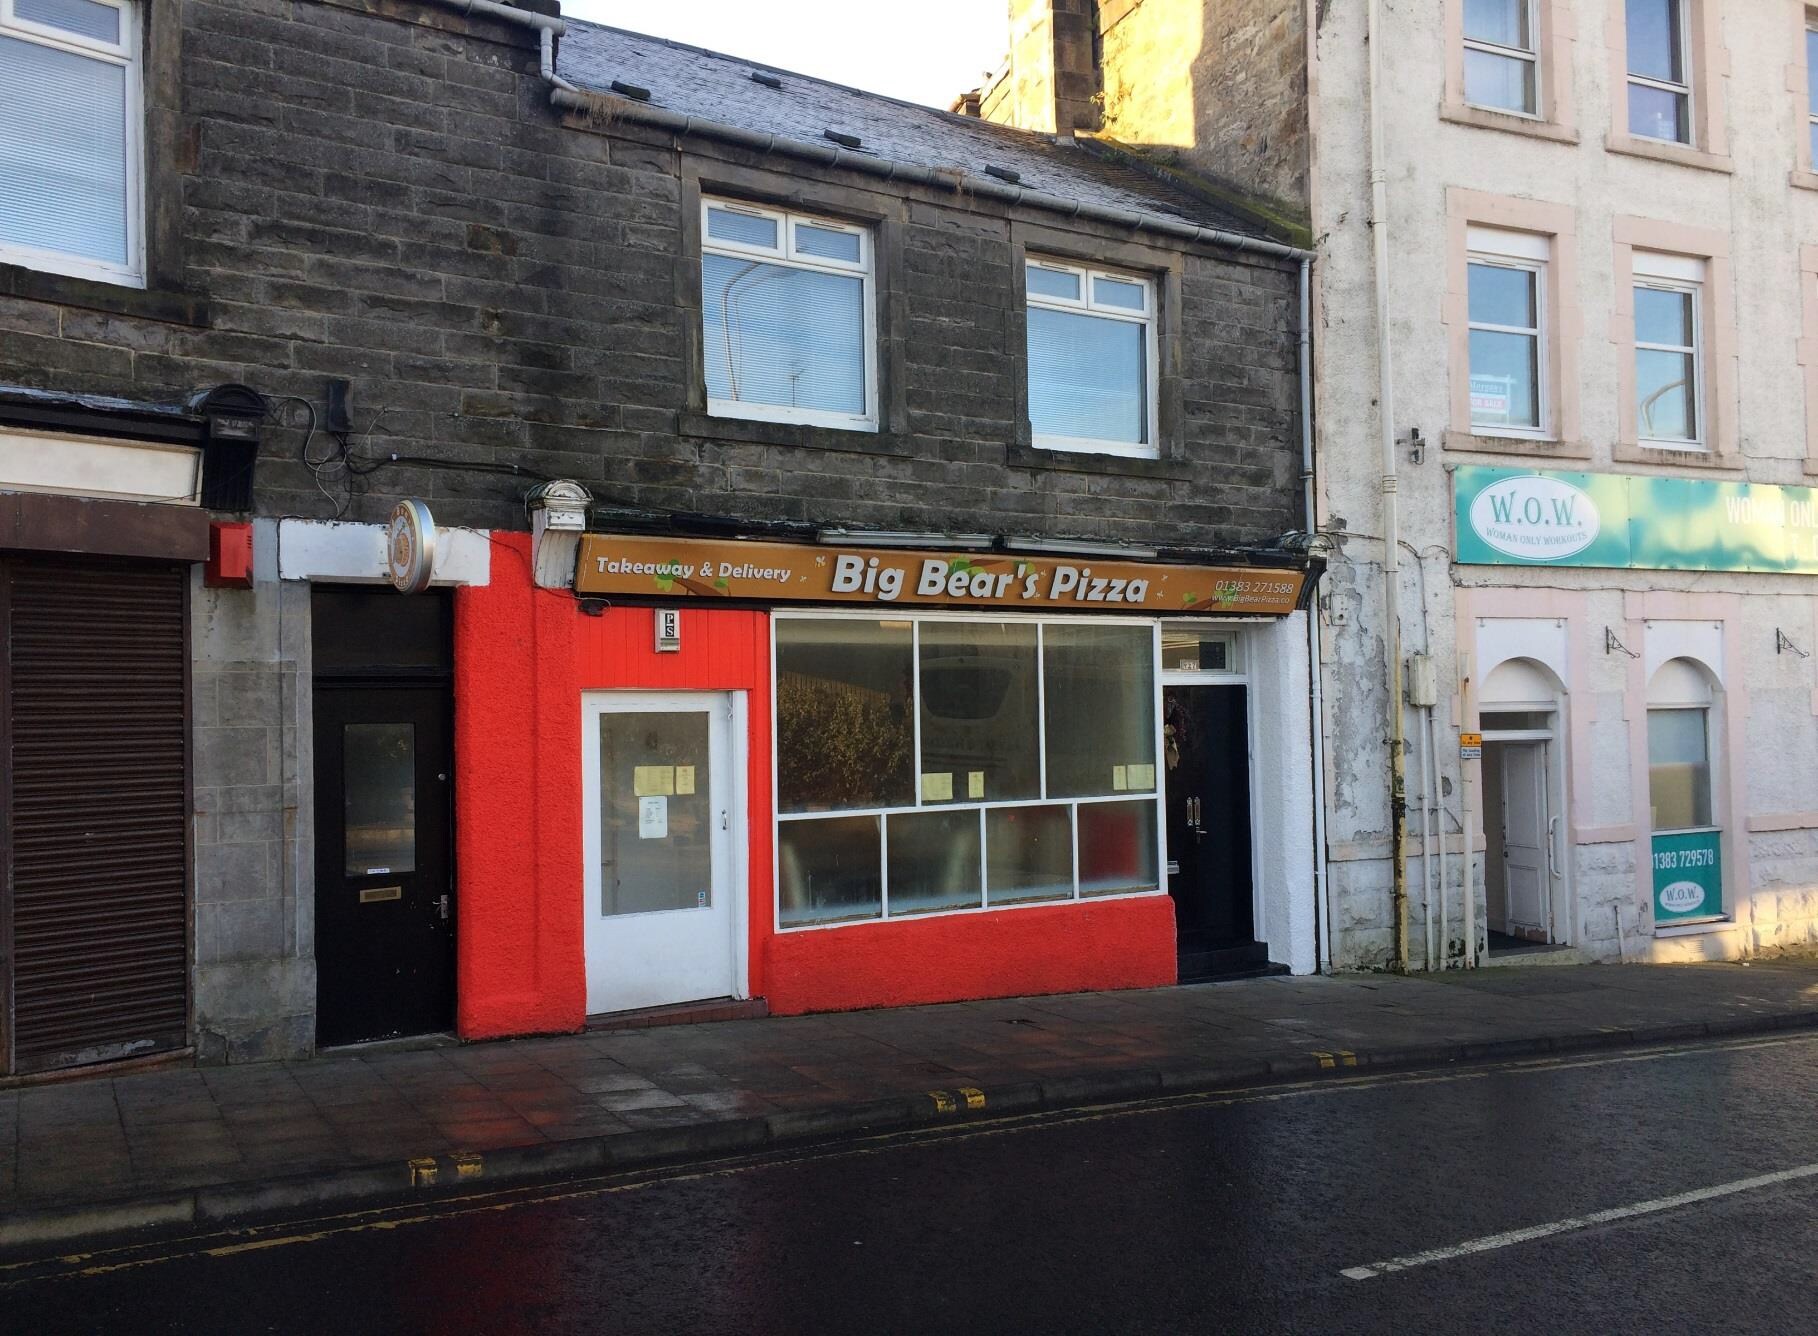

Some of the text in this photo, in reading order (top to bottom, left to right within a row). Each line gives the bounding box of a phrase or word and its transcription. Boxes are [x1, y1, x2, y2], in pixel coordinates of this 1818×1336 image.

[1489, 491, 1583, 526] W.O.W.
[1486, 527, 1588, 545] WOMAN ONLY WORKOUTS
[597, 556, 791, 583] Takeaway & Delivery
[832, 554, 1149, 602] Big Bear's Pizza
[1215, 580, 1294, 594] 01383 271588
[1679, 848, 1714, 868] 729578
[1666, 886, 1699, 901] W.O.W.
